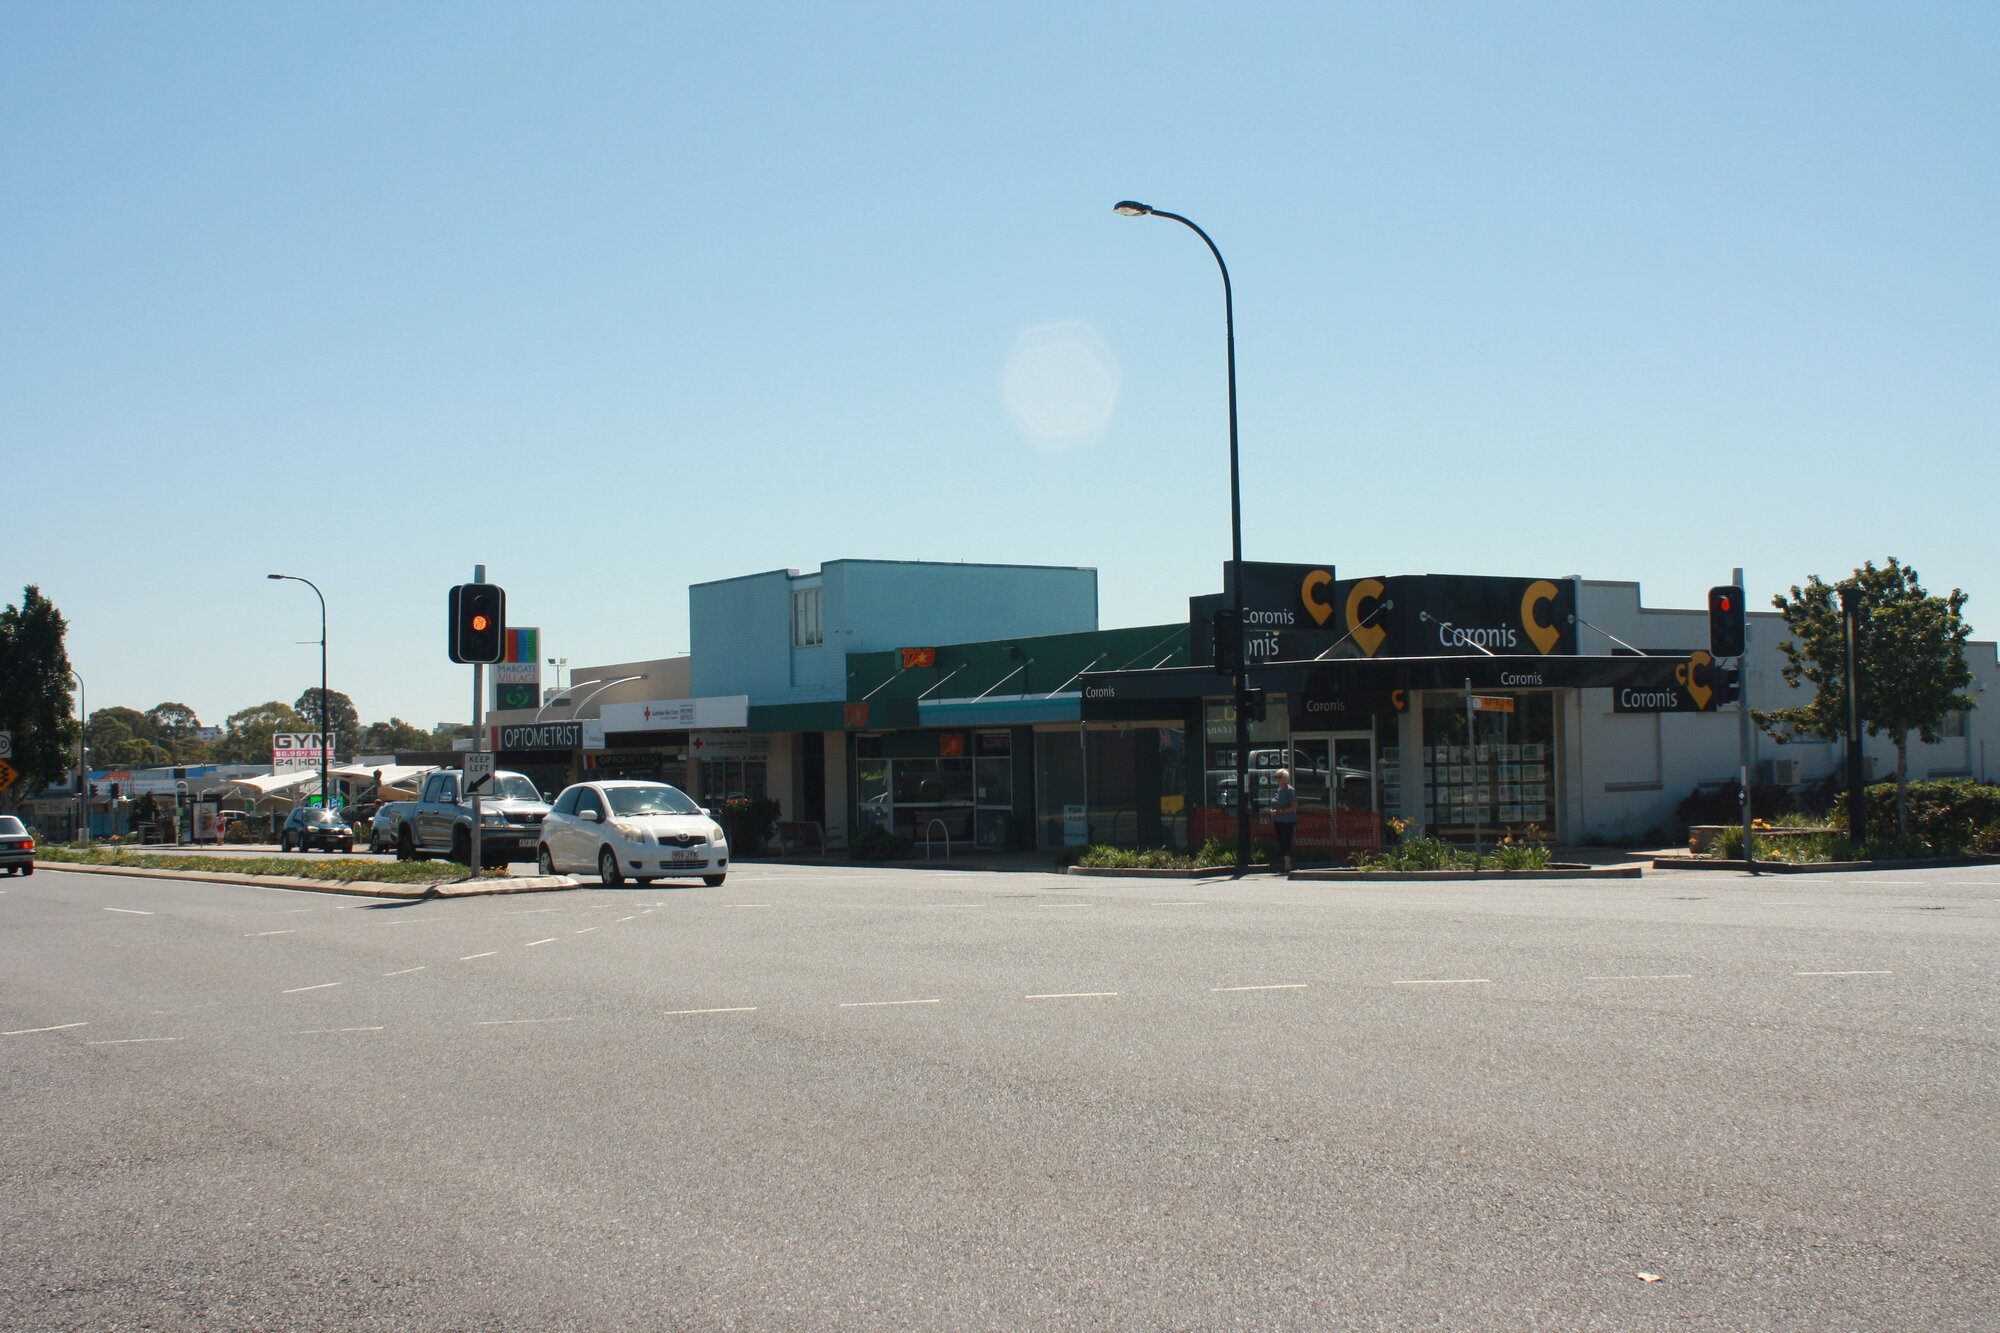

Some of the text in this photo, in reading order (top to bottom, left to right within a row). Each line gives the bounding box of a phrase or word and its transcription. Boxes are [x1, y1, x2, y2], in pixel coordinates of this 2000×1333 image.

[1439, 621, 1517, 648] Coronis
[498, 665, 537, 673] MARGATE
[498, 673, 537, 683] VILLAGE
[1501, 671, 1543, 686] Coronis
[1085, 685, 1115, 698] Coronis
[1621, 688, 1678, 708] Coronis
[1306, 699, 1345, 712] Coronis
[275, 735, 334, 748] GYM
[504, 725, 579, 748] OPTOMETRIST
[275, 758, 293, 766] 24
[469, 755, 490, 763] KEEP
[469, 764, 489, 772] LEFT
